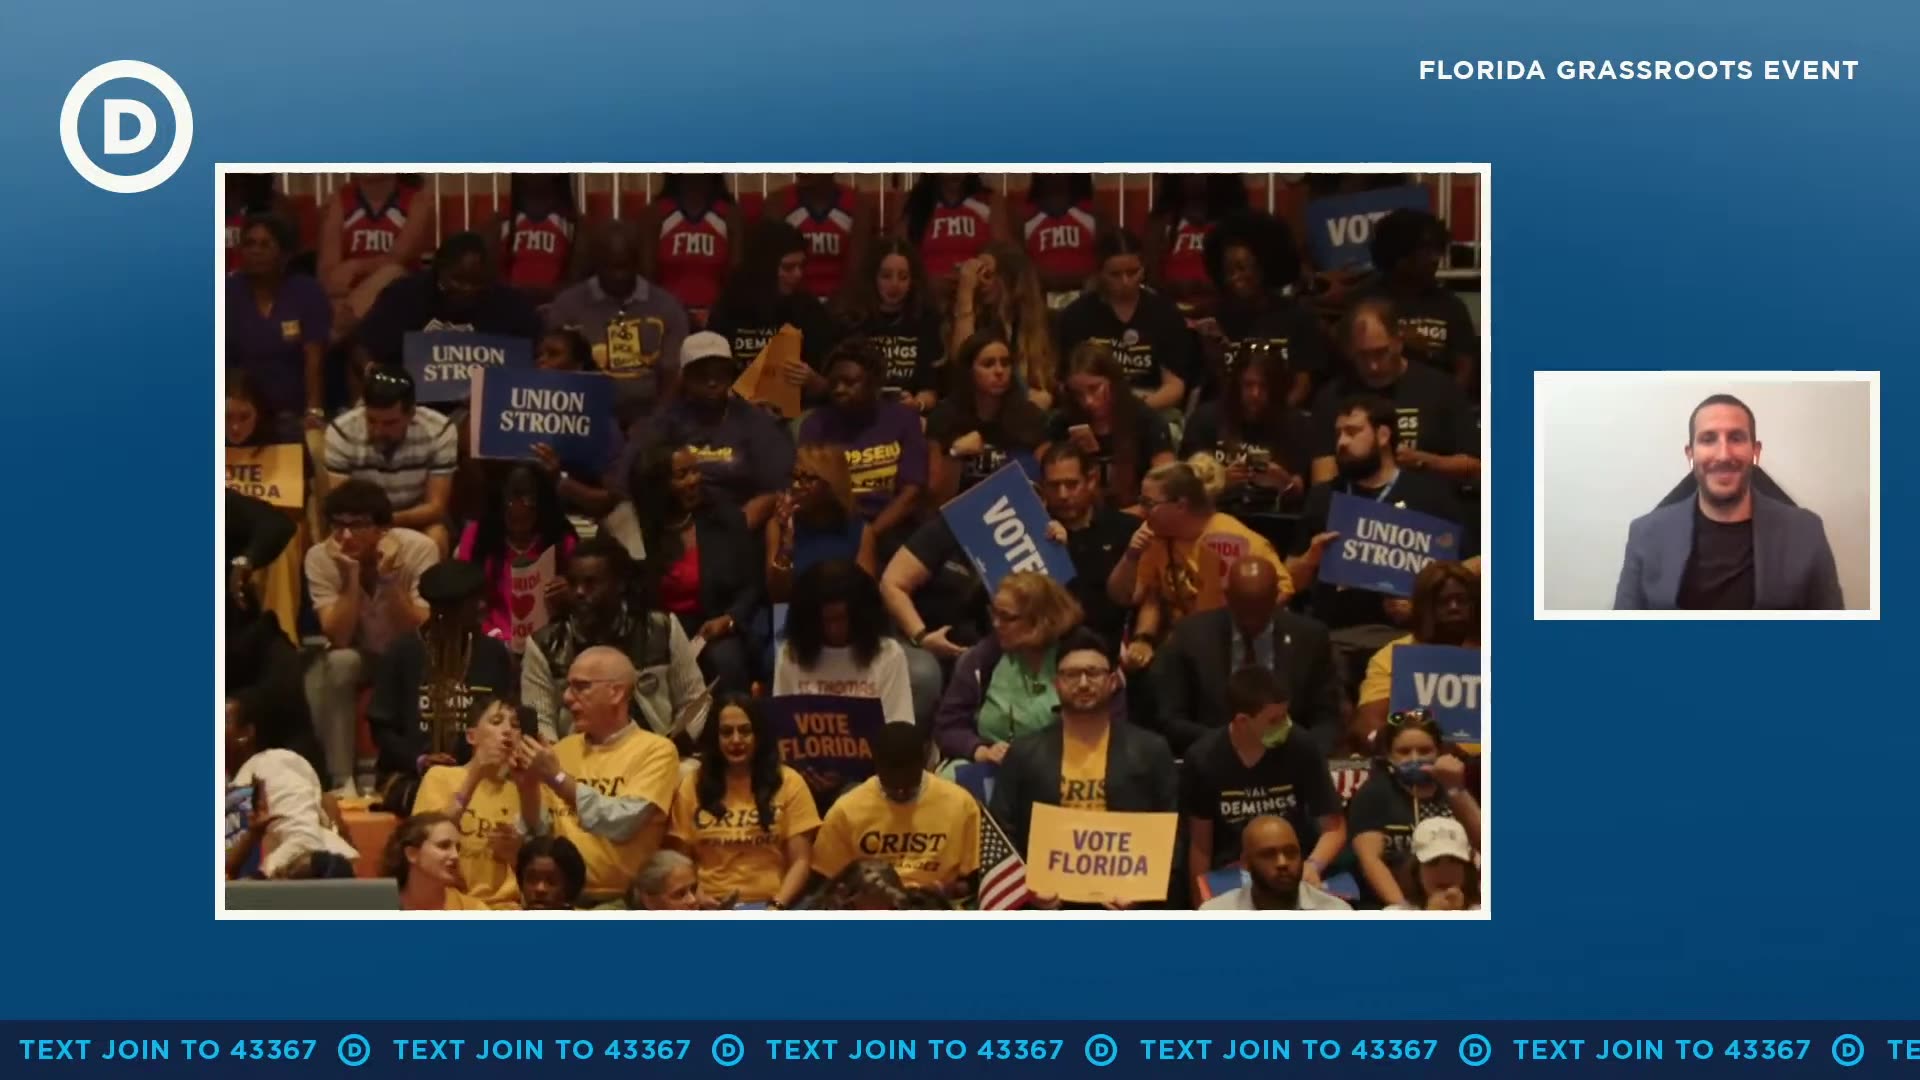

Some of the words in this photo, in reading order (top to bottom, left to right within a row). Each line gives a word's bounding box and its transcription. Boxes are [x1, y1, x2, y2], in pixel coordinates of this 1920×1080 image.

[931, 215, 976, 239] FMU
[1039, 226, 1081, 252] FMU
[351, 230, 394, 253] FMU
[513, 230, 556, 254] FMU
[671, 232, 715, 256] FMU
[432, 345, 505, 366] UNION
[510, 387, 585, 413] UNION
[500, 410, 592, 437] STRONG
[1356, 517, 1432, 555] UNION
[794, 711, 849, 735] VOTE
[778, 737, 873, 760] FLORIDA
[1220, 793, 1297, 816] DEMINGS
[859, 830, 947, 855] CRIST
[1073, 829, 1132, 852] VOTE
[1048, 850, 1148, 876] FLORIDA
